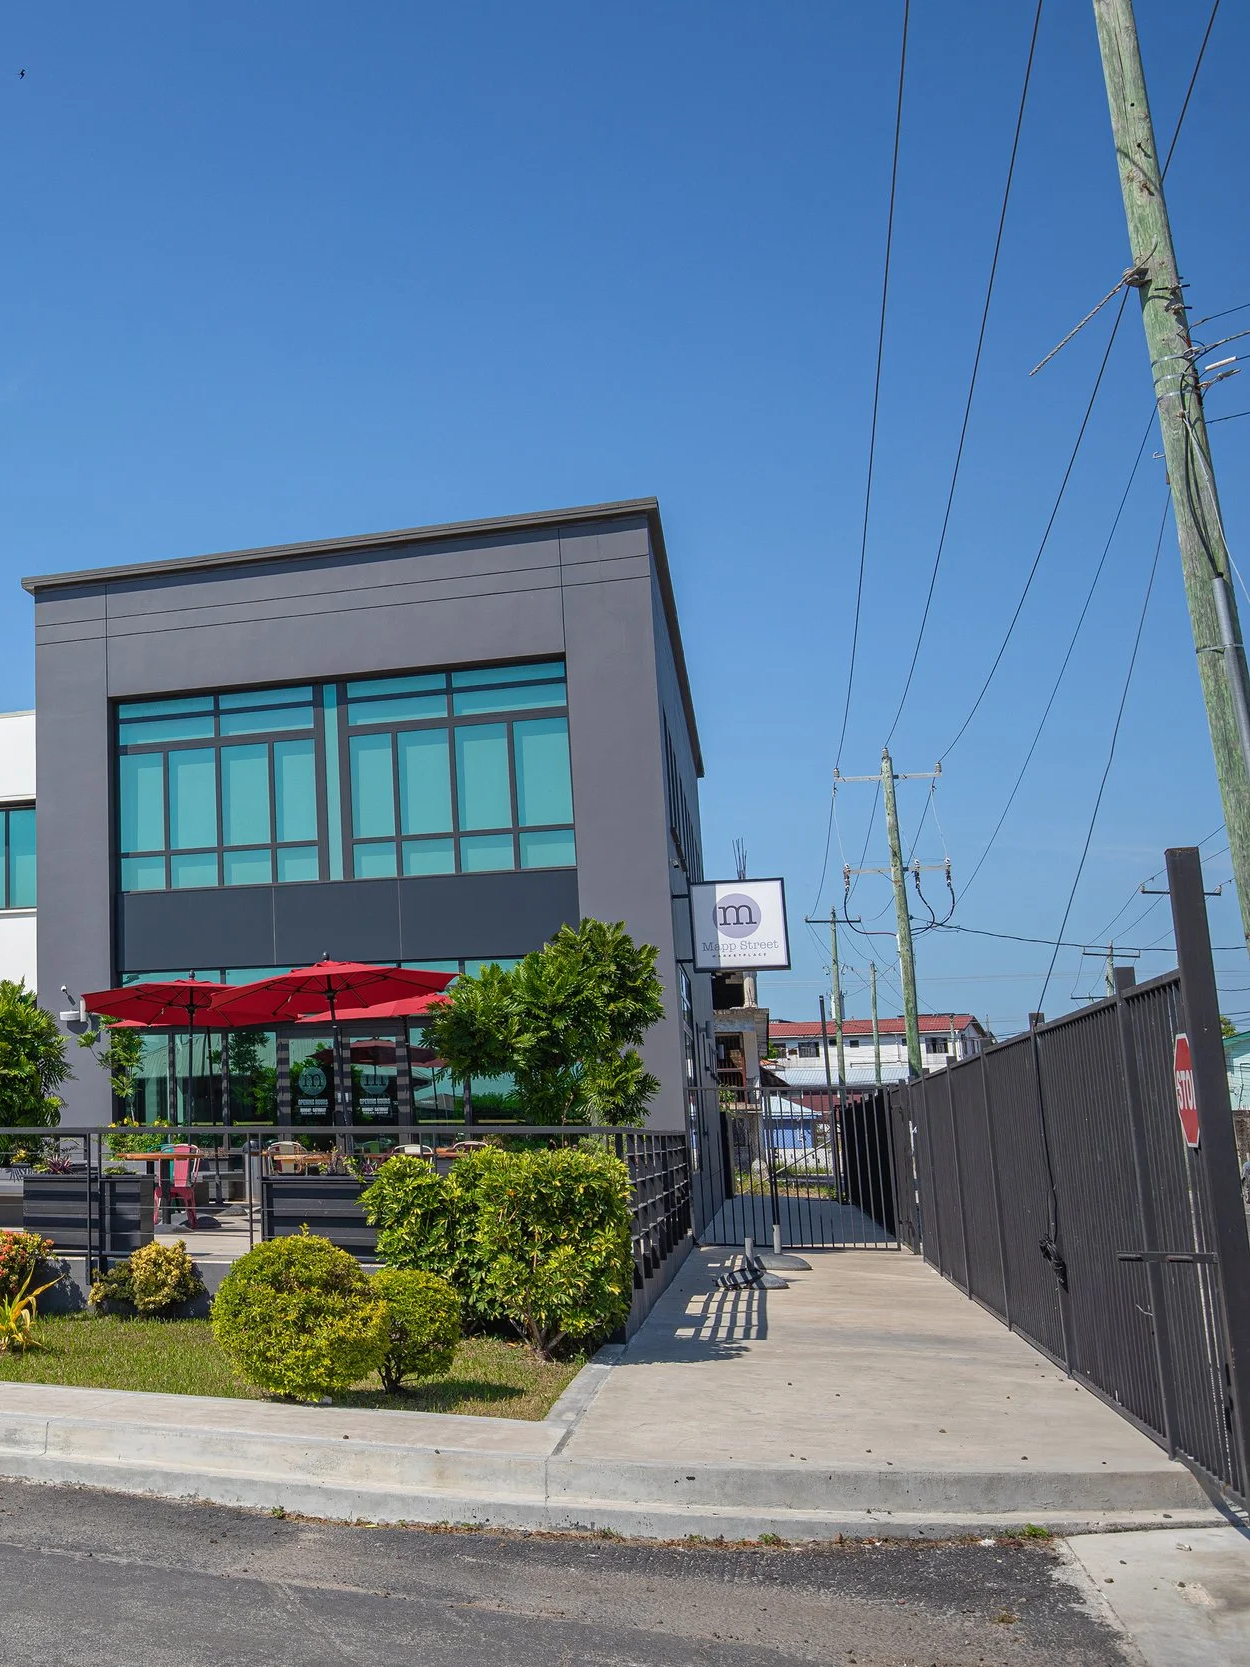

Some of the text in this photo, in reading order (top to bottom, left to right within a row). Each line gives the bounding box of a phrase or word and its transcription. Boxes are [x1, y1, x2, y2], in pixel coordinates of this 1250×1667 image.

[718, 904, 757, 926] m
[702, 940, 779, 952] Mapp Street
